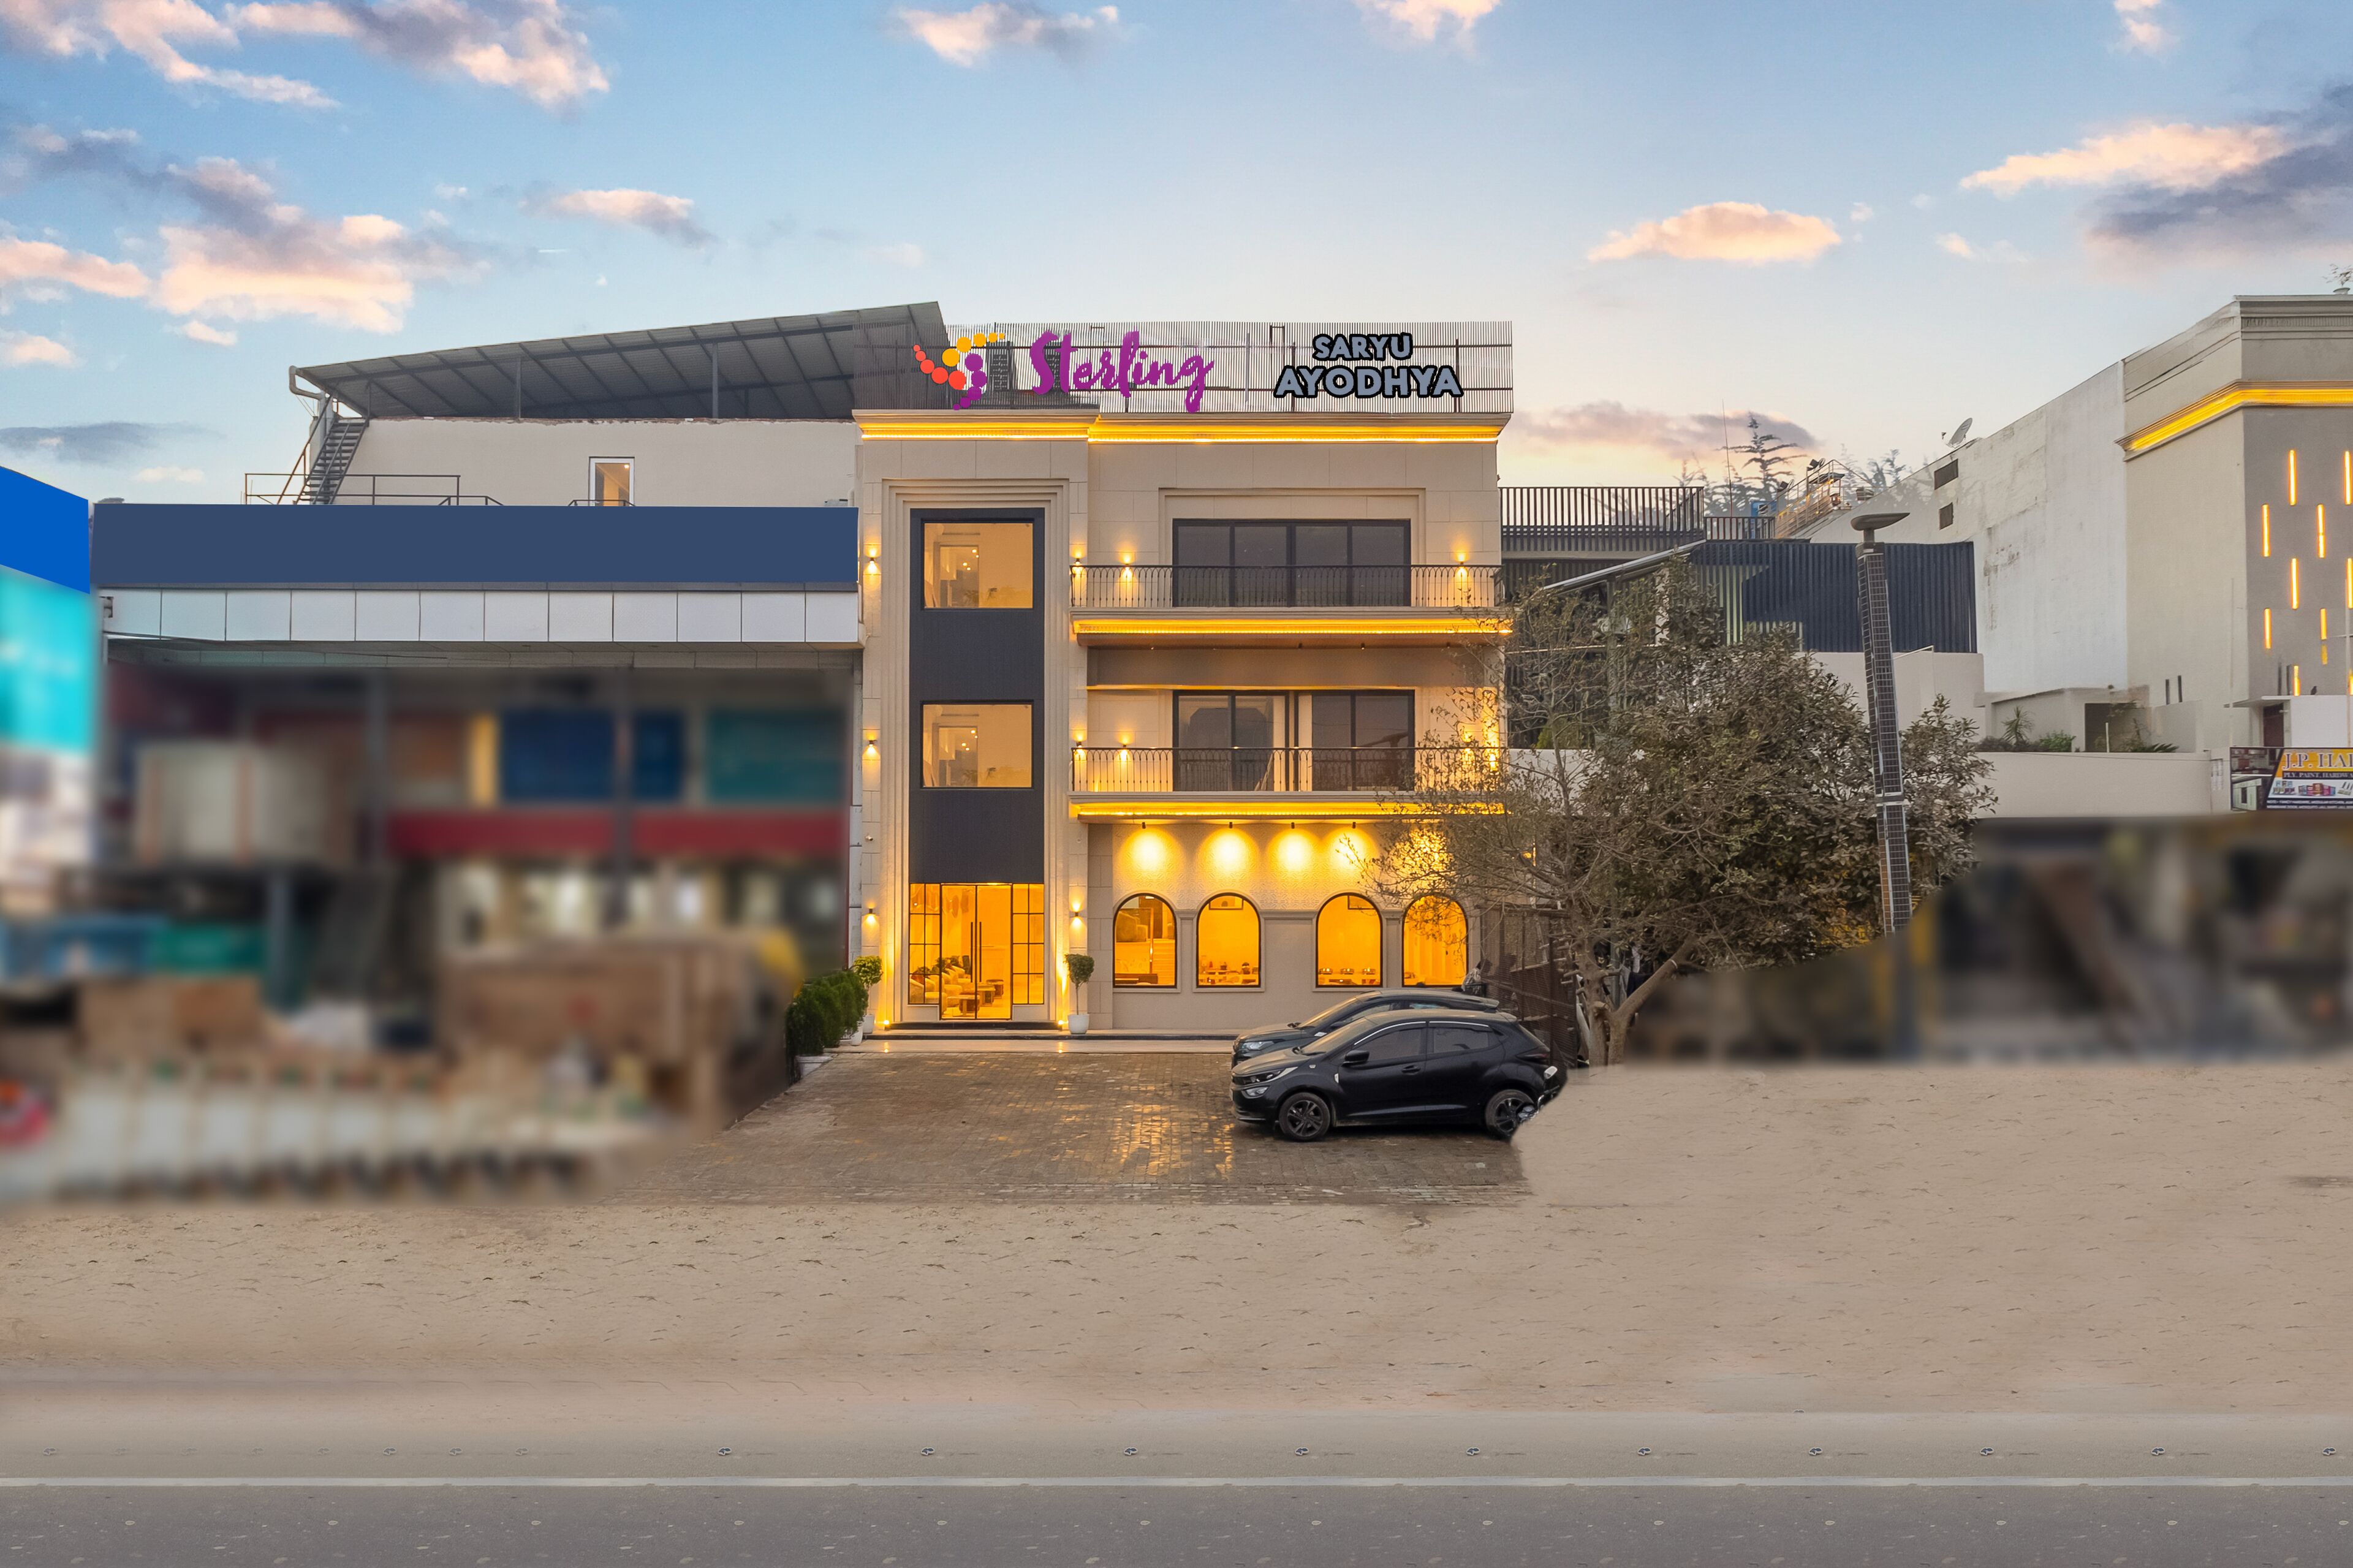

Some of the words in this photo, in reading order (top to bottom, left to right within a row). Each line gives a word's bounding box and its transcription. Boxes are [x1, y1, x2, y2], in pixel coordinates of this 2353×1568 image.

[1313, 332, 1413, 361] SARYU
[1030, 328, 1214, 414] Sterling
[1273, 365, 1464, 398] AYODHYA
